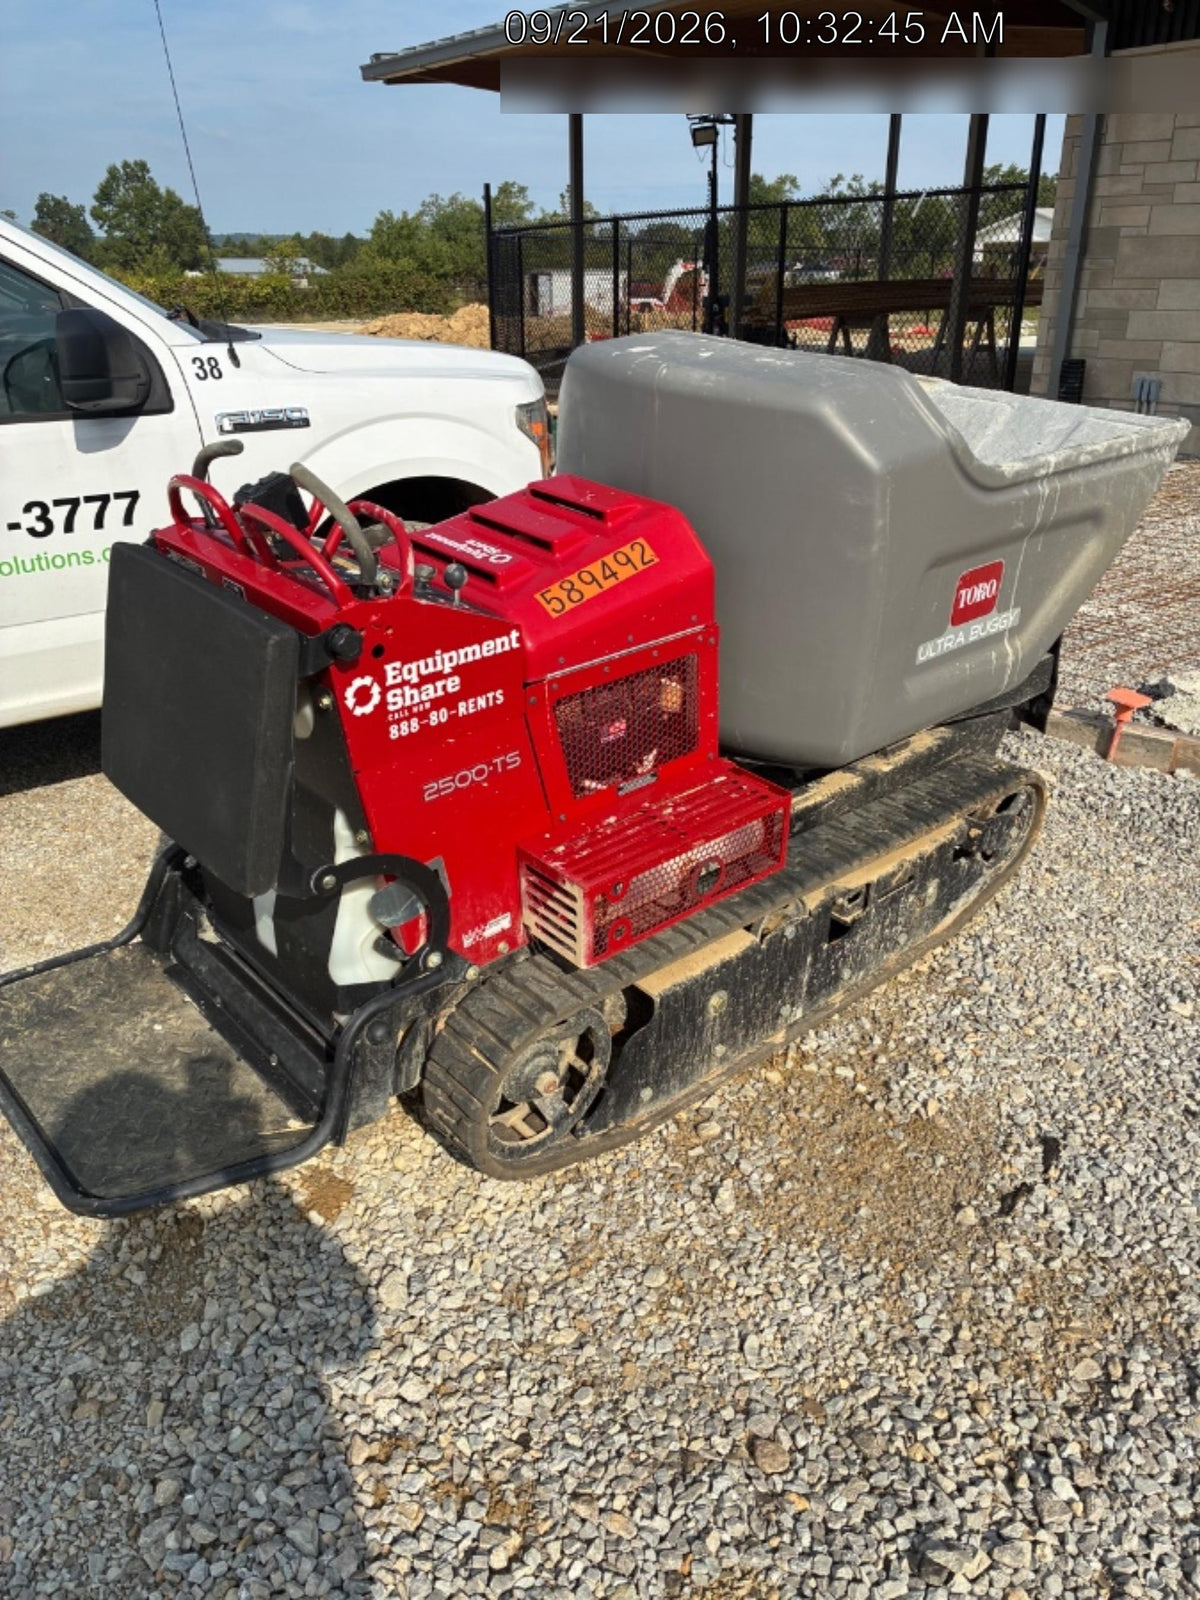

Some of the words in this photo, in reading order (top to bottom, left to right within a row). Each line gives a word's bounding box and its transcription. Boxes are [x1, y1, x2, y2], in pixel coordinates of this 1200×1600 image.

[192, 356, 223, 381] 38
[7, 490, 140, 538] -3777
[540, 541, 655, 614] 589492
[958, 579, 998, 609] TORO
[384, 629, 520, 686] Equipment
[918, 632, 966, 661] ULTRA
[968, 611, 1015, 641] BUGGY
[386, 675, 461, 712] Share
[389, 689, 505, 740] 888-80-RENTS
